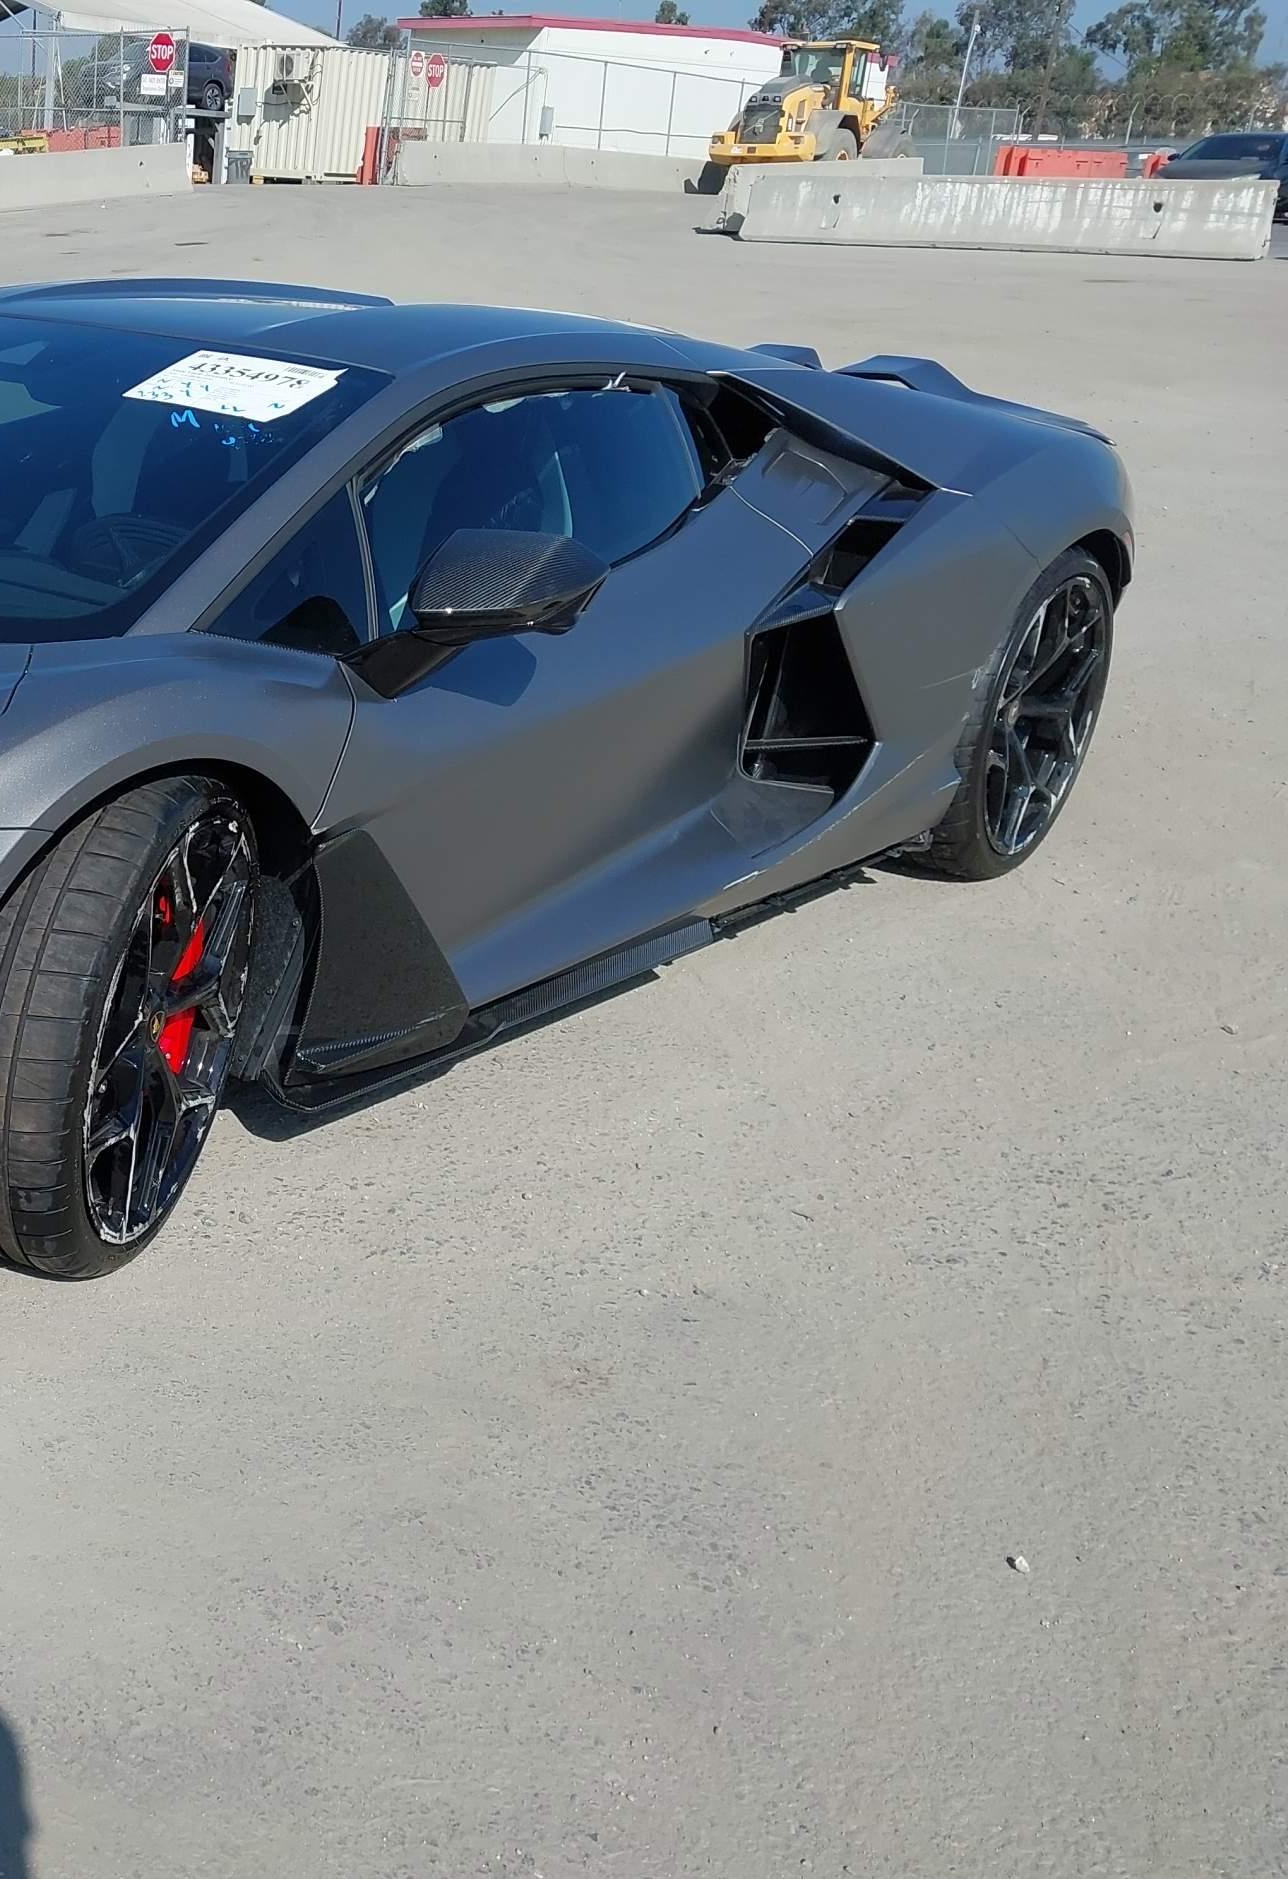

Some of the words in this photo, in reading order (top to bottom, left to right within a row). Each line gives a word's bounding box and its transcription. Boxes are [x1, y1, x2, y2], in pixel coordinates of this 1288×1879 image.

[151, 44, 173, 60] STOP
[428, 64, 443, 78] STOP
[189, 362, 312, 389] 43354978
